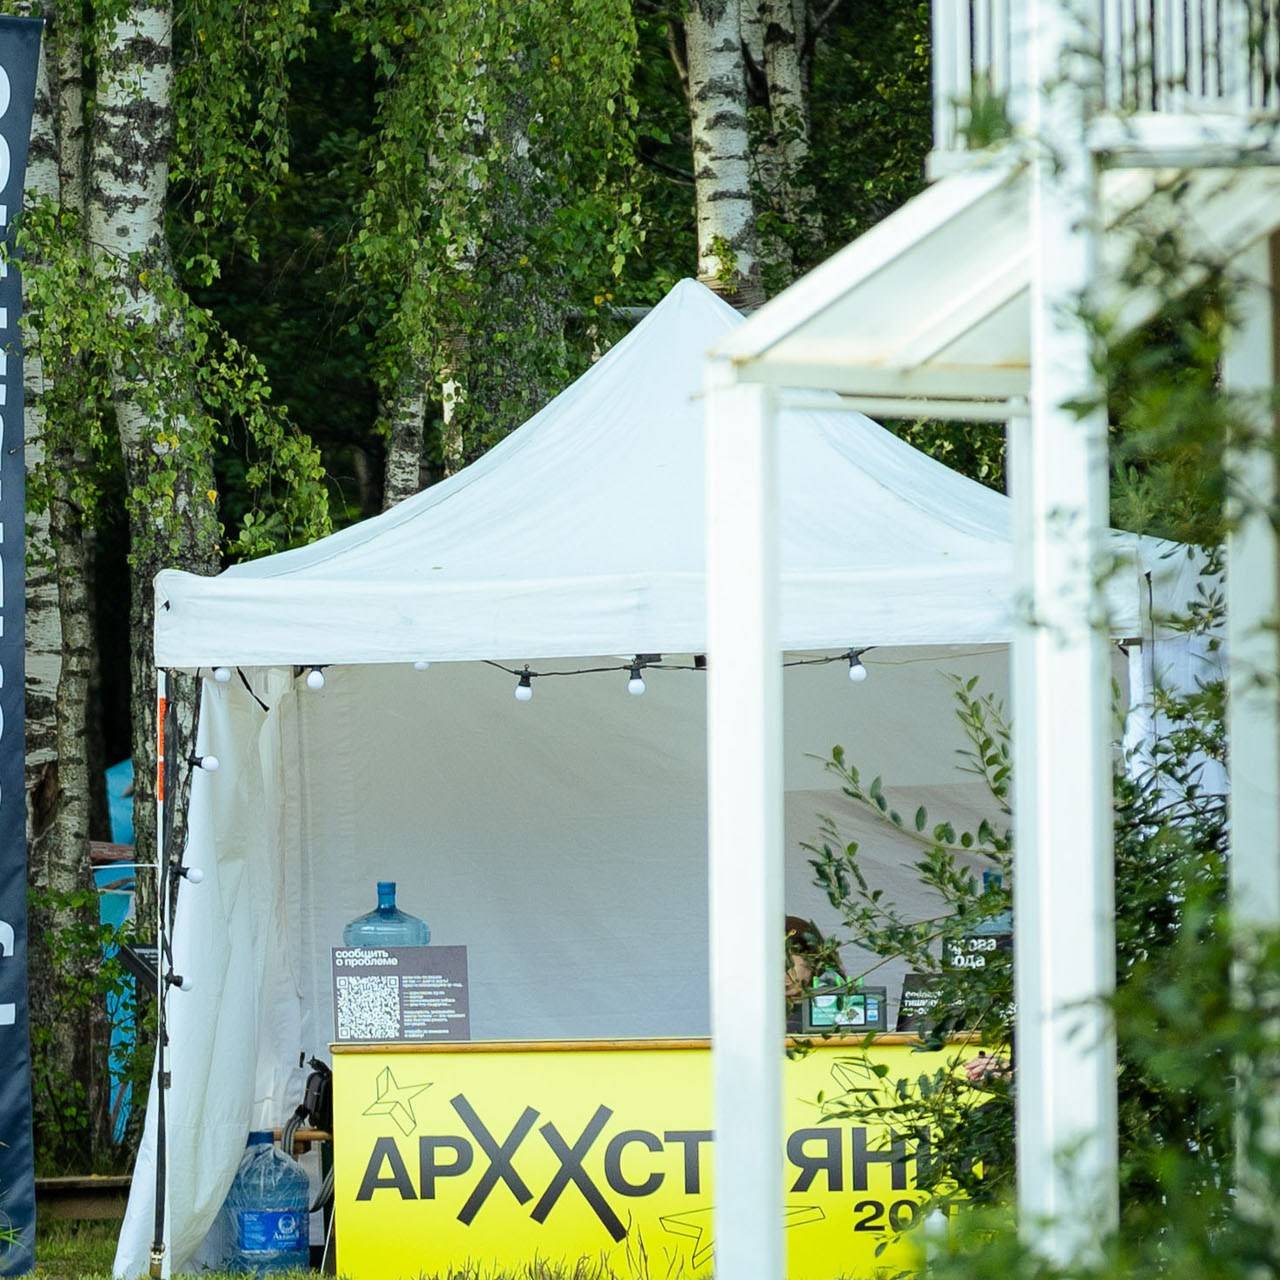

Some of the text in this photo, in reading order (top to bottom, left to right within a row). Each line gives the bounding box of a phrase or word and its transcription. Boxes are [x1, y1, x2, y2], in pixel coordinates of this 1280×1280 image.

[335, 948, 389, 959] сообщить
[335, 957, 399, 968] о проблеме
